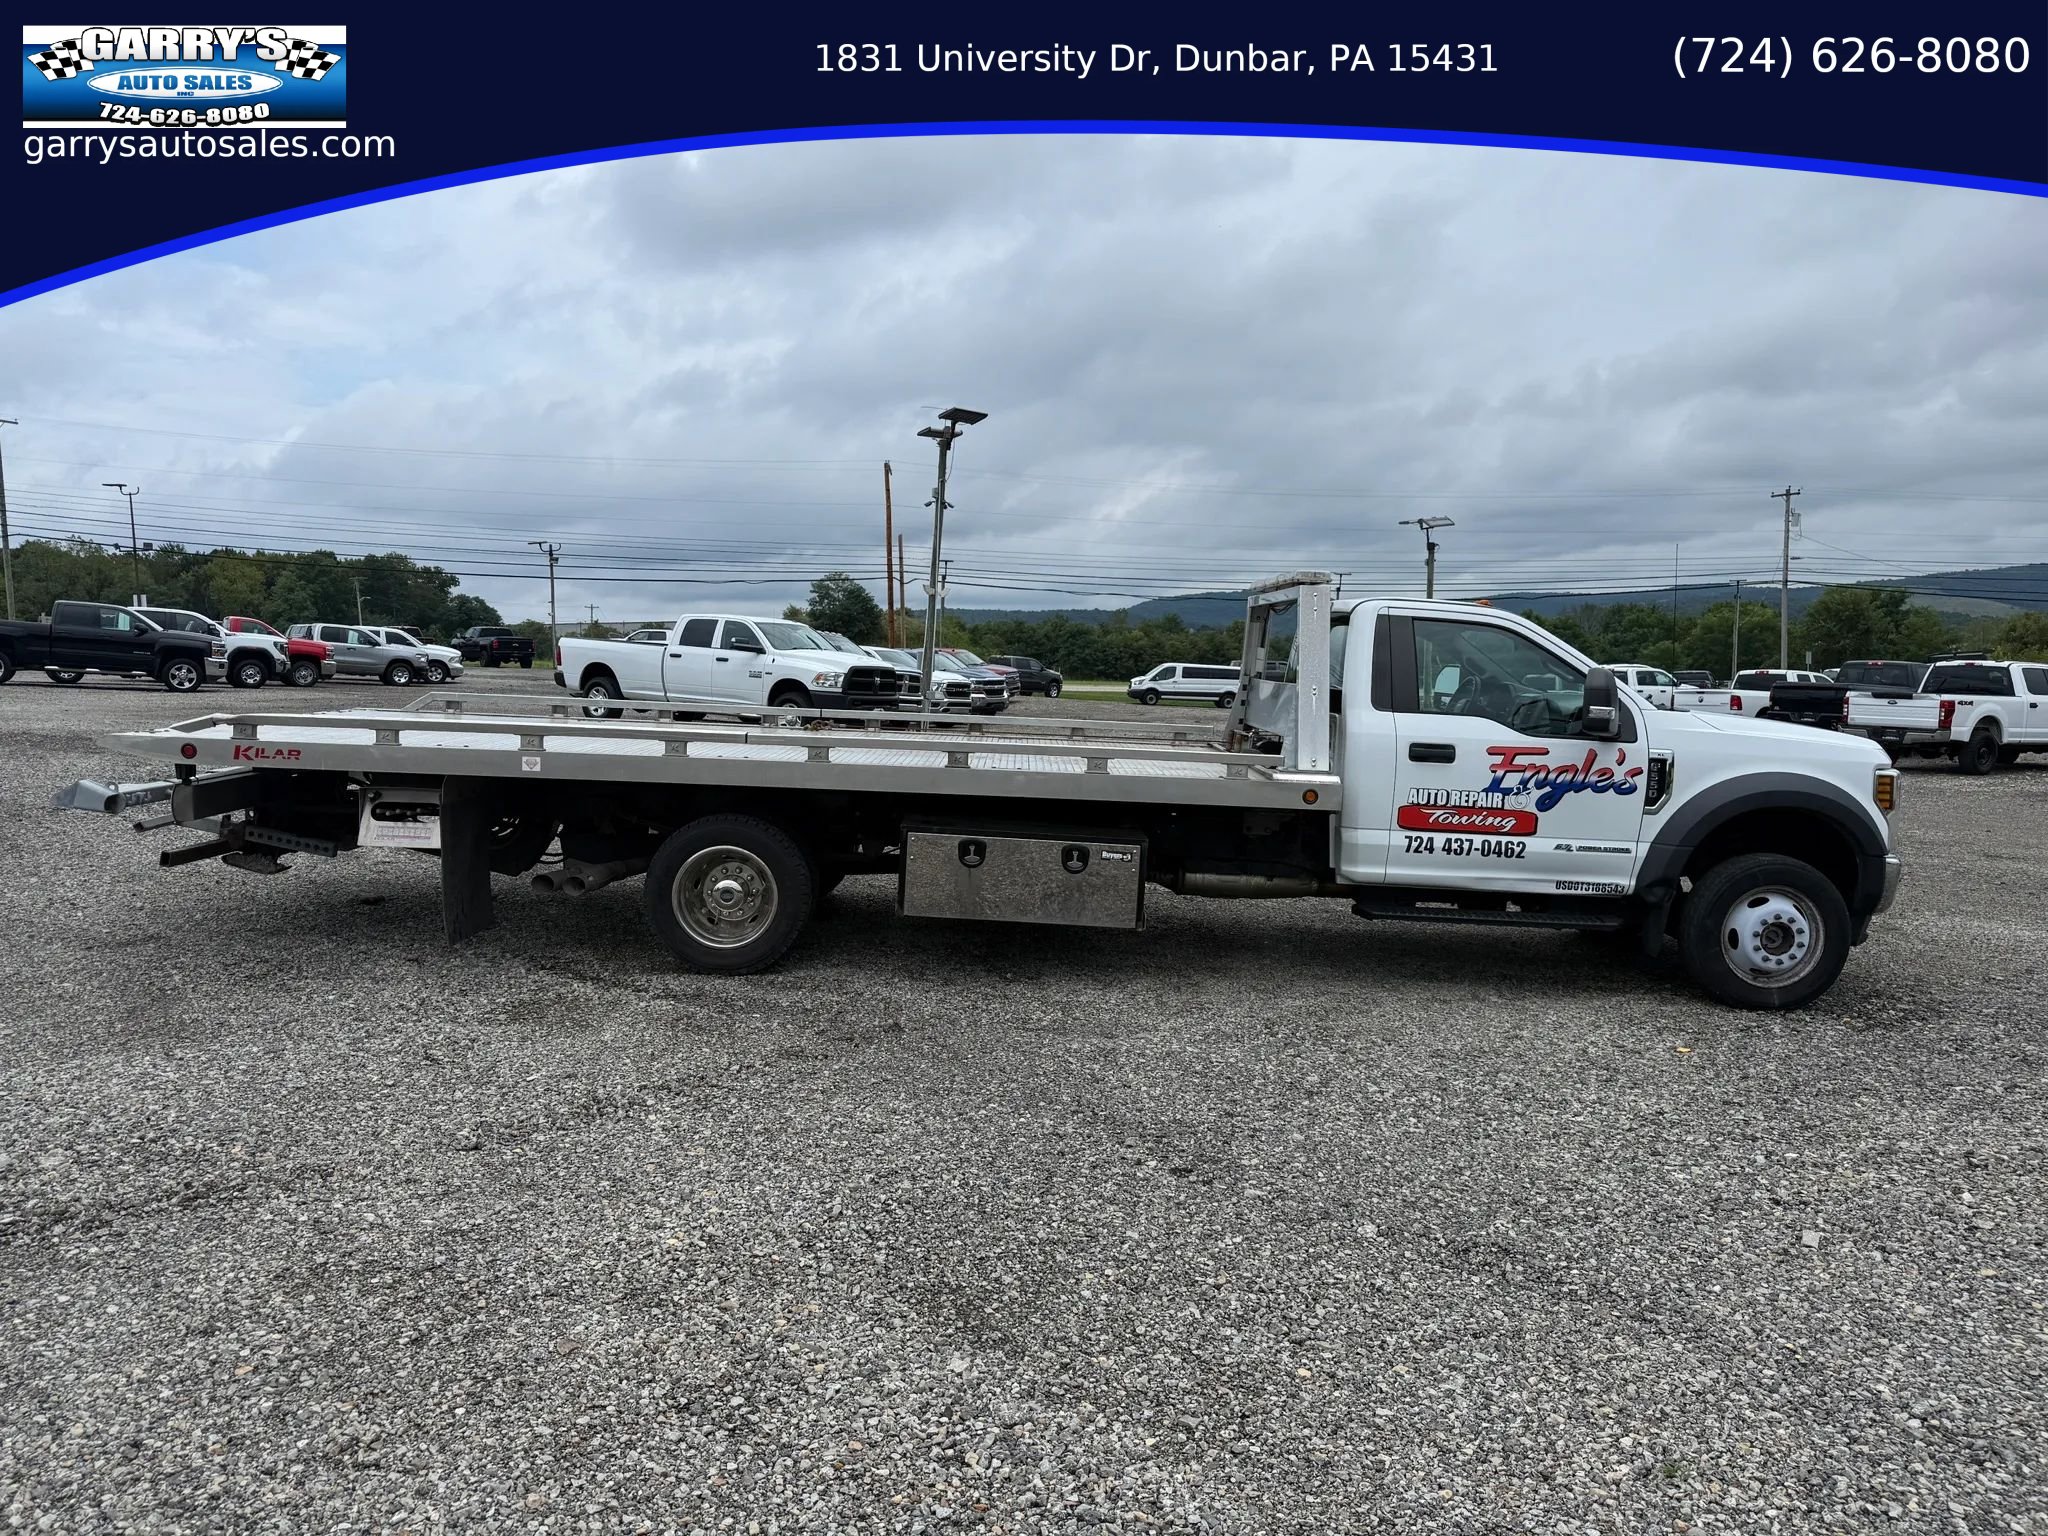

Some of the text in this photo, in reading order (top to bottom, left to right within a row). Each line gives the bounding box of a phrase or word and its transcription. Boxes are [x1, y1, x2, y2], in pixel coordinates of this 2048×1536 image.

[233, 744, 302, 760] KILAR
[1483, 745, 1645, 812] Engle's
[1407, 787, 1448, 806] AUTO
[1450, 789, 1505, 809] REPAIR
[1420, 808, 1517, 832] Towing
[1404, 835, 1527, 859] 724 437-0462
